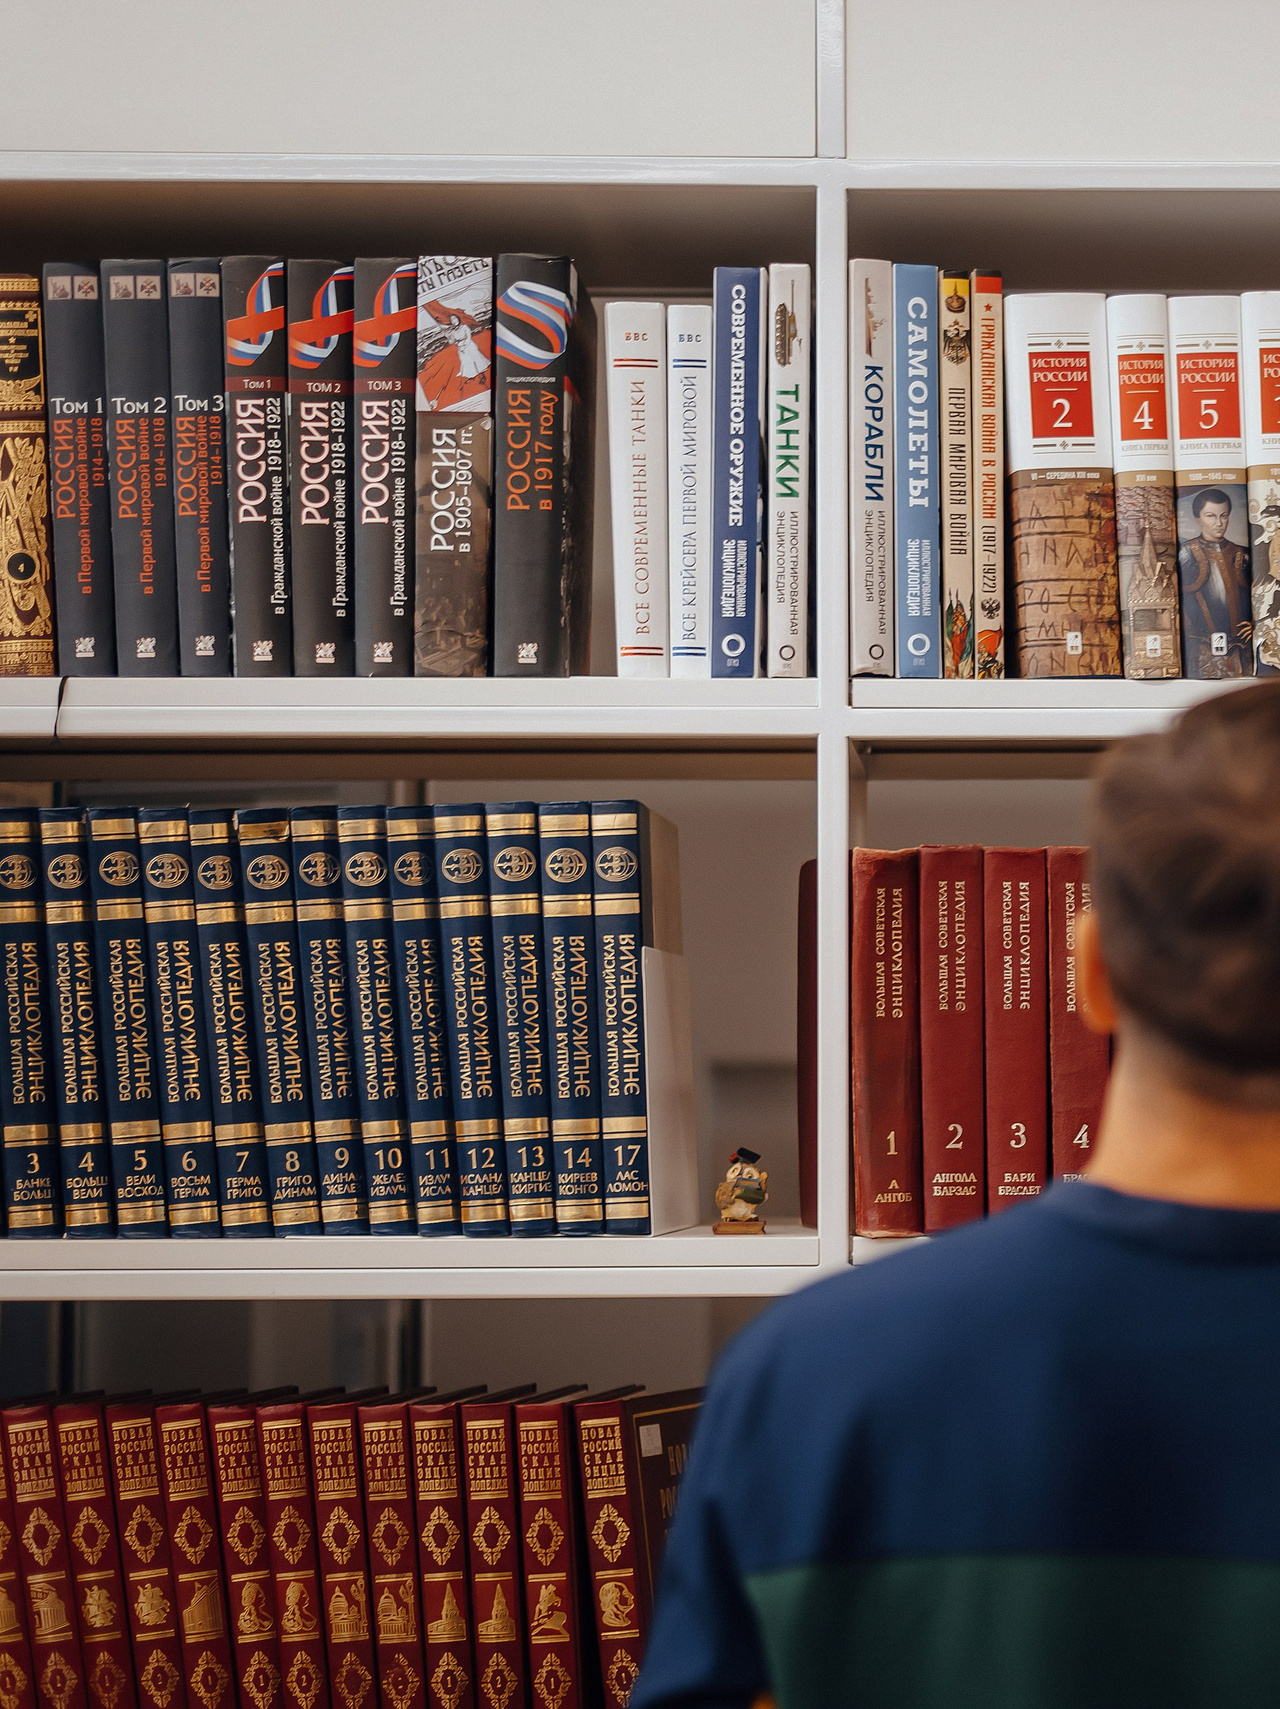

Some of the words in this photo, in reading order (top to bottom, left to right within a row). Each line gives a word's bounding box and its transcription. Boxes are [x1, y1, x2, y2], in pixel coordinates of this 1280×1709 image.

[439, 259, 489, 282] ГАЗЕТЪ
[729, 284, 747, 435] СОВРЕМЕННОЕ
[980, 317, 996, 408] ГРАЖДАНСКАЯ
[1033, 357, 1087, 368] ИСТОРИЯ
[1033, 371, 1088, 383] РОССИИ
[1119, 359, 1164, 371] ИСТОРИЯ
[1120, 373, 1165, 385] РОССИИ
[1180, 358, 1235, 370] ИСТОРИЯ
[1181, 372, 1236, 384] РОССИИ
[174, 395, 208, 412] Том
[212, 395, 224, 411] 3
[267, 380, 271, 389] 1
[306, 382, 333, 392] ТОМ
[334, 383, 341, 393] 2
[367, 381, 393, 391] ТОМ
[394, 381, 402, 391] 3
[907, 297, 929, 508] САМОЛЕТЫ
[51, 397, 88, 414] Том
[95, 397, 103, 414] 1
[111, 397, 149, 414] Том
[153, 397, 167, 414] 2
[540, 390, 559, 436] году
[631, 381, 646, 446] ТАНКИ
[680, 375, 698, 457] МИРОВОЙ
[948, 387, 966, 436] ПЕРВАЯ
[1052, 398, 1073, 428] 2
[1133, 400, 1154, 430] 4
[1199, 399, 1219, 430] 5
[76, 418, 88, 461] войне
[460, 426, 473, 445] гг.
[507, 389, 531, 511] РОССИЯ
[775, 384, 800, 498] ТАНКИ
[864, 365, 884, 501] КОРАБЛИ
[982, 414, 999, 453] ВОЙНА
[1180, 443, 1209, 451] КНИГА
[1210, 442, 1243, 450] ПЕРВАЯ
[54, 419, 76, 519] РОССИЯ
[116, 419, 138, 519] РОССИЯ
[176, 416, 197, 516] РОССИЯ
[235, 398, 267, 523] РОССИЯ
[300, 401, 330, 526] РОССИЯ
[361, 400, 390, 525] РОССИЯ
[534, 443, 553, 490] 1917
[949, 443, 967, 505] МИРОВАЯ
[76, 464, 92, 525] мировой
[270, 476, 283, 515] войне
[430, 428, 456, 552] РОССИЯ
[680, 463, 698, 526] ПЕРВОЙ
[728, 438, 745, 527] ОРУЖИЕ
[982, 473, 996, 519] РОССИИ
[539, 500, 553, 511] в
[632, 453, 650, 595] СОВРЕМЕННЫЕ
[459, 543, 471, 552] в
[950, 513, 971, 556] ВОЙНА
[78, 529, 94, 583] Первой
[270, 516, 288, 604] Гражданской
[680, 531, 697, 607] КРЕЙСЕРА
[776, 511, 785, 604] ЭНЦИКЛОПЕДИЯ
[790, 511, 799, 635] ИЛЛЮСТРИРОВАННАЯ
[864, 510, 874, 602] ЭНЦИКЛОПЕДИЯ
[877, 510, 886, 635] ИЛЛЮСТРИРОВАННАЯ
[82, 586, 92, 594] в
[721, 539, 736, 618] ЭНЦИКЛОПЕДИЯ
[907, 539, 920, 617] ЭНЦИКЛОПЕДИЯ
[922, 539, 932, 617] ИЛЛЮСТРИРОВАННАЯ
[275, 606, 285, 615] в
[636, 602, 650, 635] ВСЕ
[682, 613, 697, 641] ВСЕ
[1003, 881, 1012, 949] СОВЕТСКАЯ
[1019, 881, 1031, 1010] ЭНЦИКЛОПЕДИЯ
[109, 939, 127, 1031] РОССИЙСКАЯ
[602, 934, 618, 1026] РОССИЙСКАЯ
[1003, 955, 1013, 1010] БОЛЬШАЯ
[125, 938, 151, 1100] ЭНЦИКЛОПЕДИЯ
[619, 934, 641, 1096] ЭНЦИКЛОПЕДИЯ
[115, 1035, 131, 1101] БОЛЬШАЯ
[606, 1030, 620, 1097] БОЛЬШАЯ
[613, 1144, 642, 1167] 17
[886, 1130, 898, 1156] 1
[1010, 1122, 1027, 1148] 3
[134, 1150, 148, 1171] 5
[285, 1151, 301, 1172] 8
[557, 1172, 598, 1184] КИРЕЕВ
[560, 1146, 593, 1169] 14
[615, 1170, 639, 1182] ЛАС
[1004, 1173, 1036, 1183] БАРИ
[126, 1175, 156, 1187] ВЕЛИ
[274, 1185, 317, 1201] ДИНАМ
[276, 1175, 313, 1187] ГРИГО
[559, 1182, 599, 1195] КОНГО
[606, 1181, 649, 1193] ЛОМОН
[998, 1185, 1042, 1195] БРАСЛЕТ
[582, 1426, 621, 1440] НОВАЯ
[583, 1437, 622, 1453] РОССИЙ
[584, 1451, 623, 1465] СКАЯ
[585, 1464, 625, 1477] ЭНЦИК
